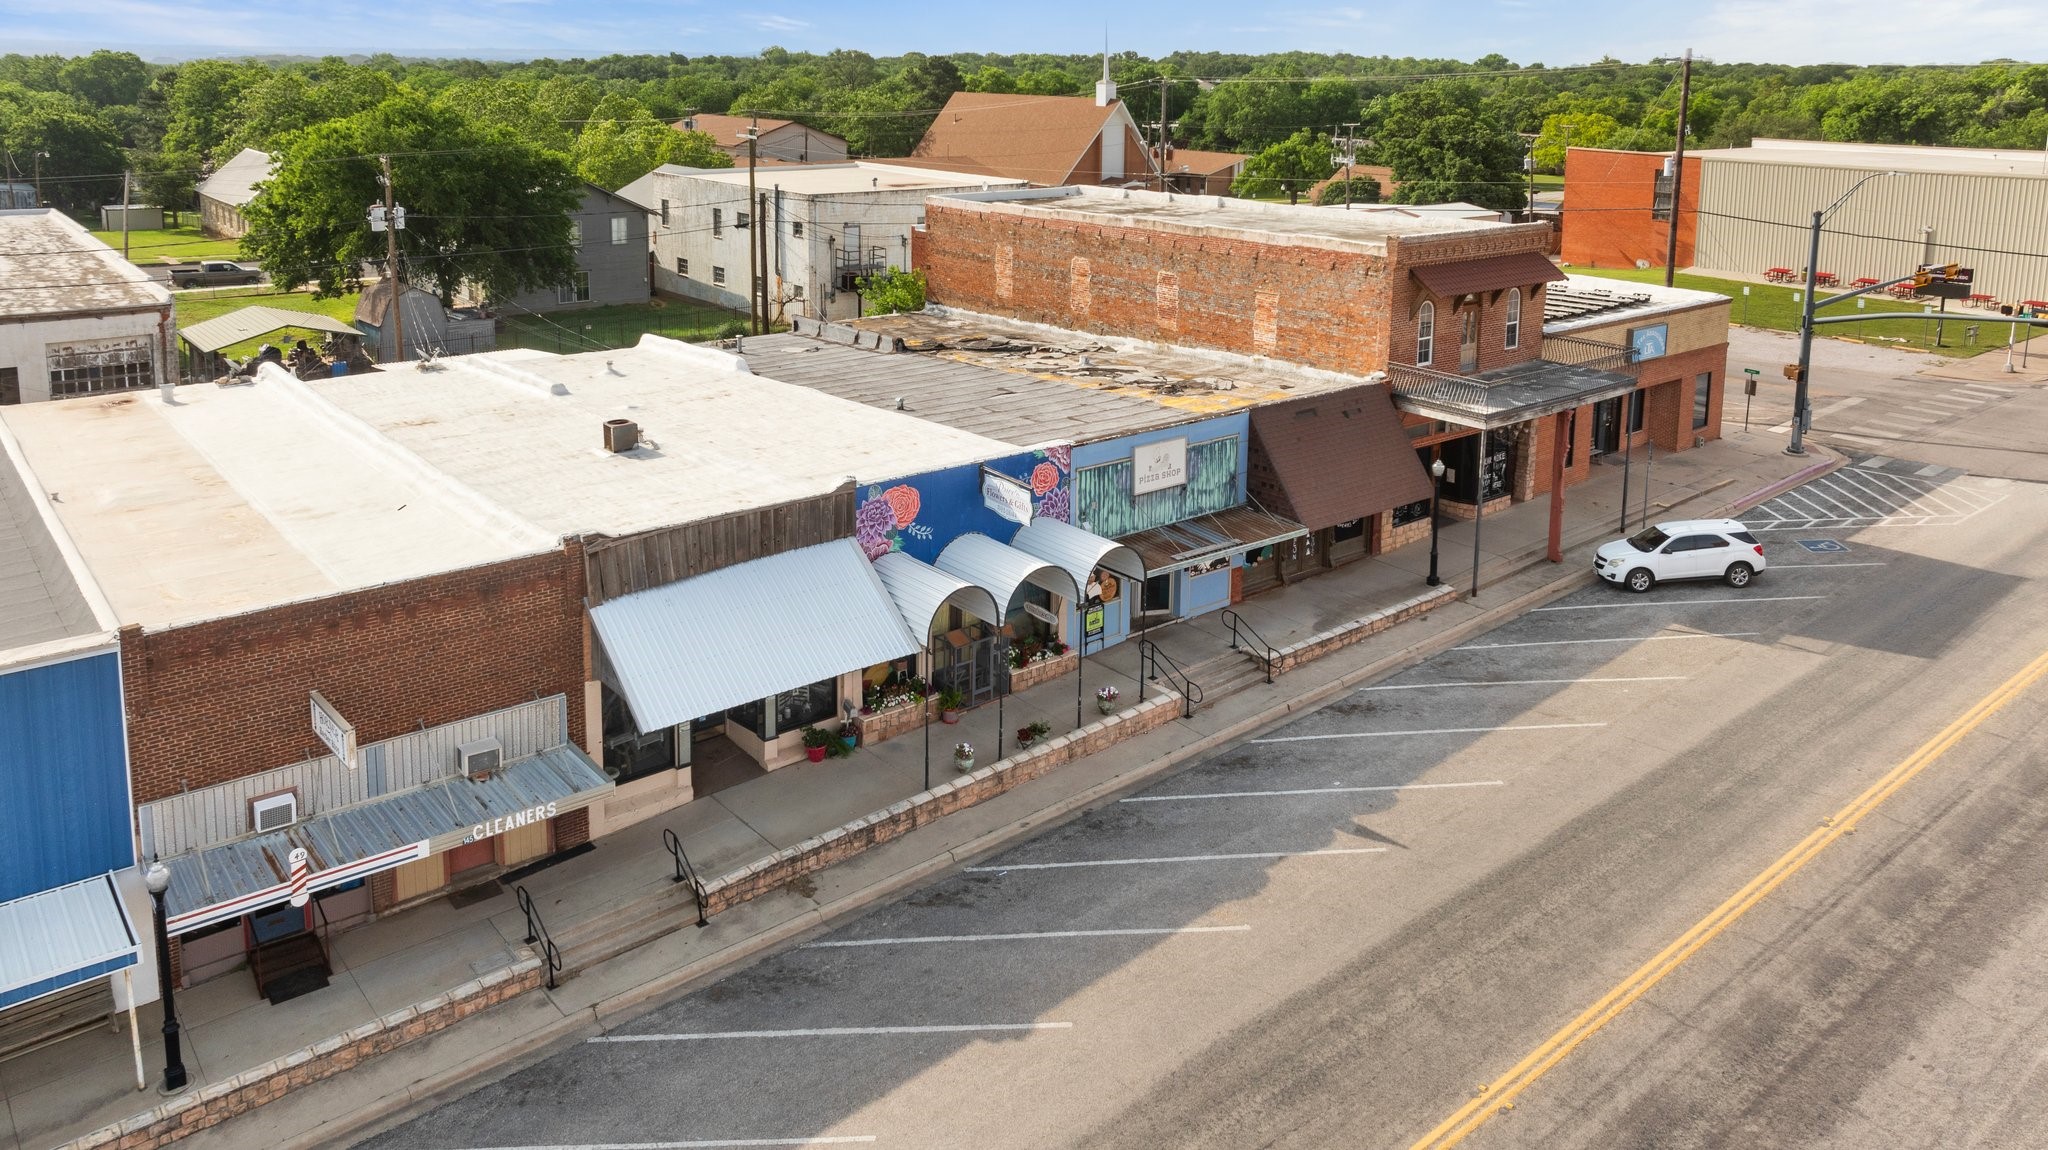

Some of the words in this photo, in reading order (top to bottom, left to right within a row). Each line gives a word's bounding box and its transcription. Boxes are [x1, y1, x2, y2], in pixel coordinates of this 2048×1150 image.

[1161, 468, 1181, 480] SHOP
[986, 487, 1008, 504] Flowers
[1014, 500, 1029, 512] Gifts
[472, 802, 557, 840] CLEANERS
[294, 851, 305, 860] 49
